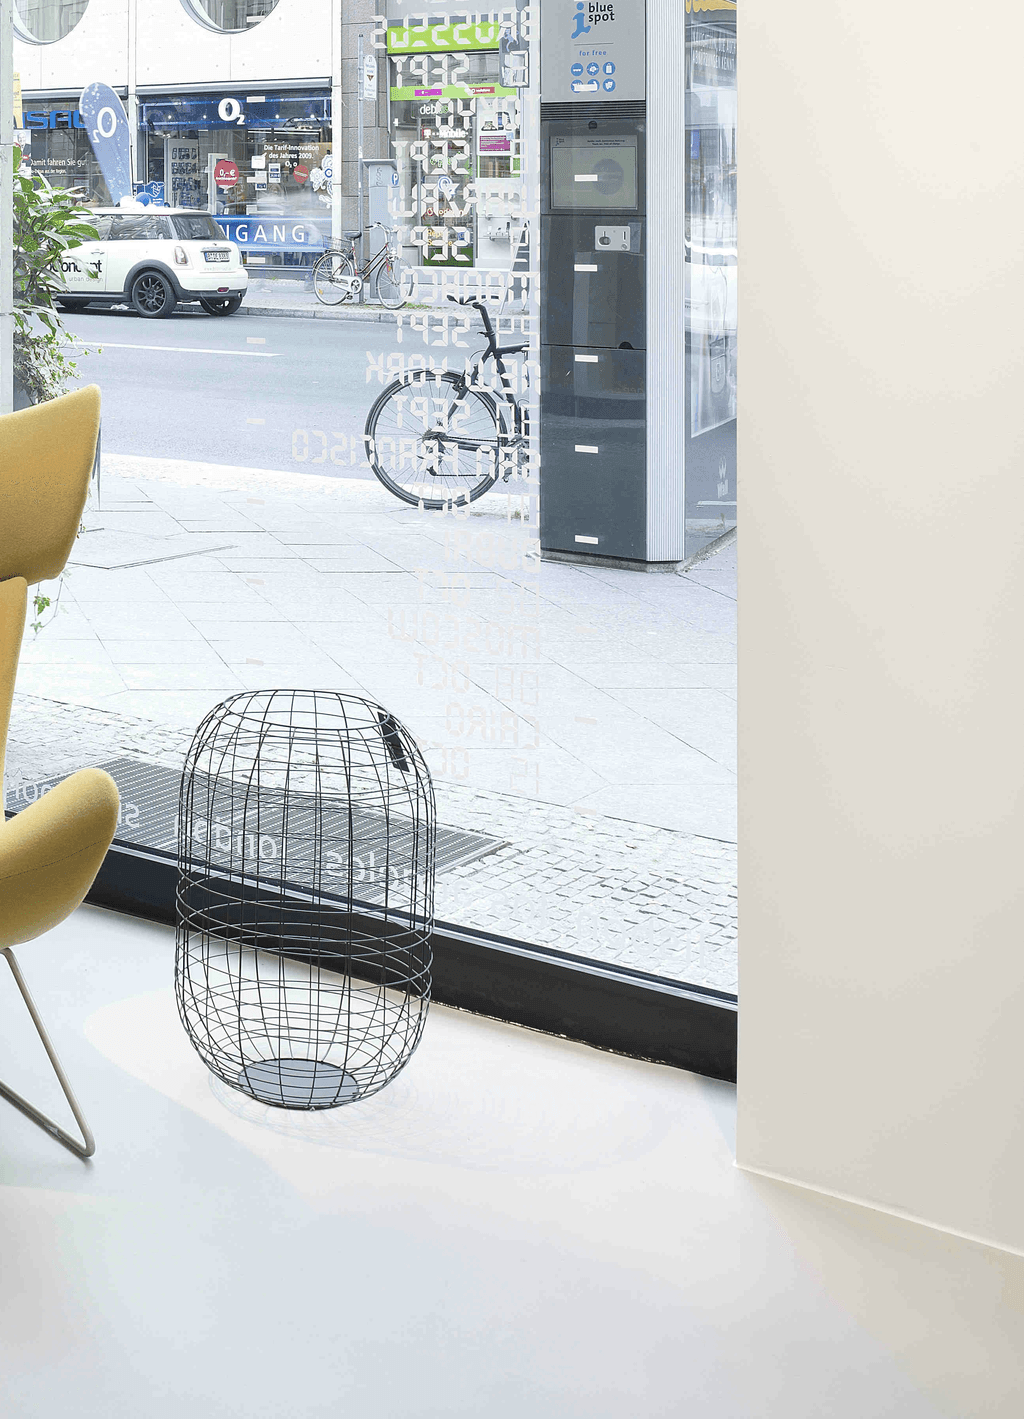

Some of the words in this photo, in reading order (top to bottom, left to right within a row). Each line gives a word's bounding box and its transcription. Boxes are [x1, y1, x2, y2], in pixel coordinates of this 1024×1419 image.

[588, 2, 614, 13] blue
[588, 12, 615, 25] spot
[47, 158, 66, 166] fahren
[219, 224, 305, 243] NGANG
